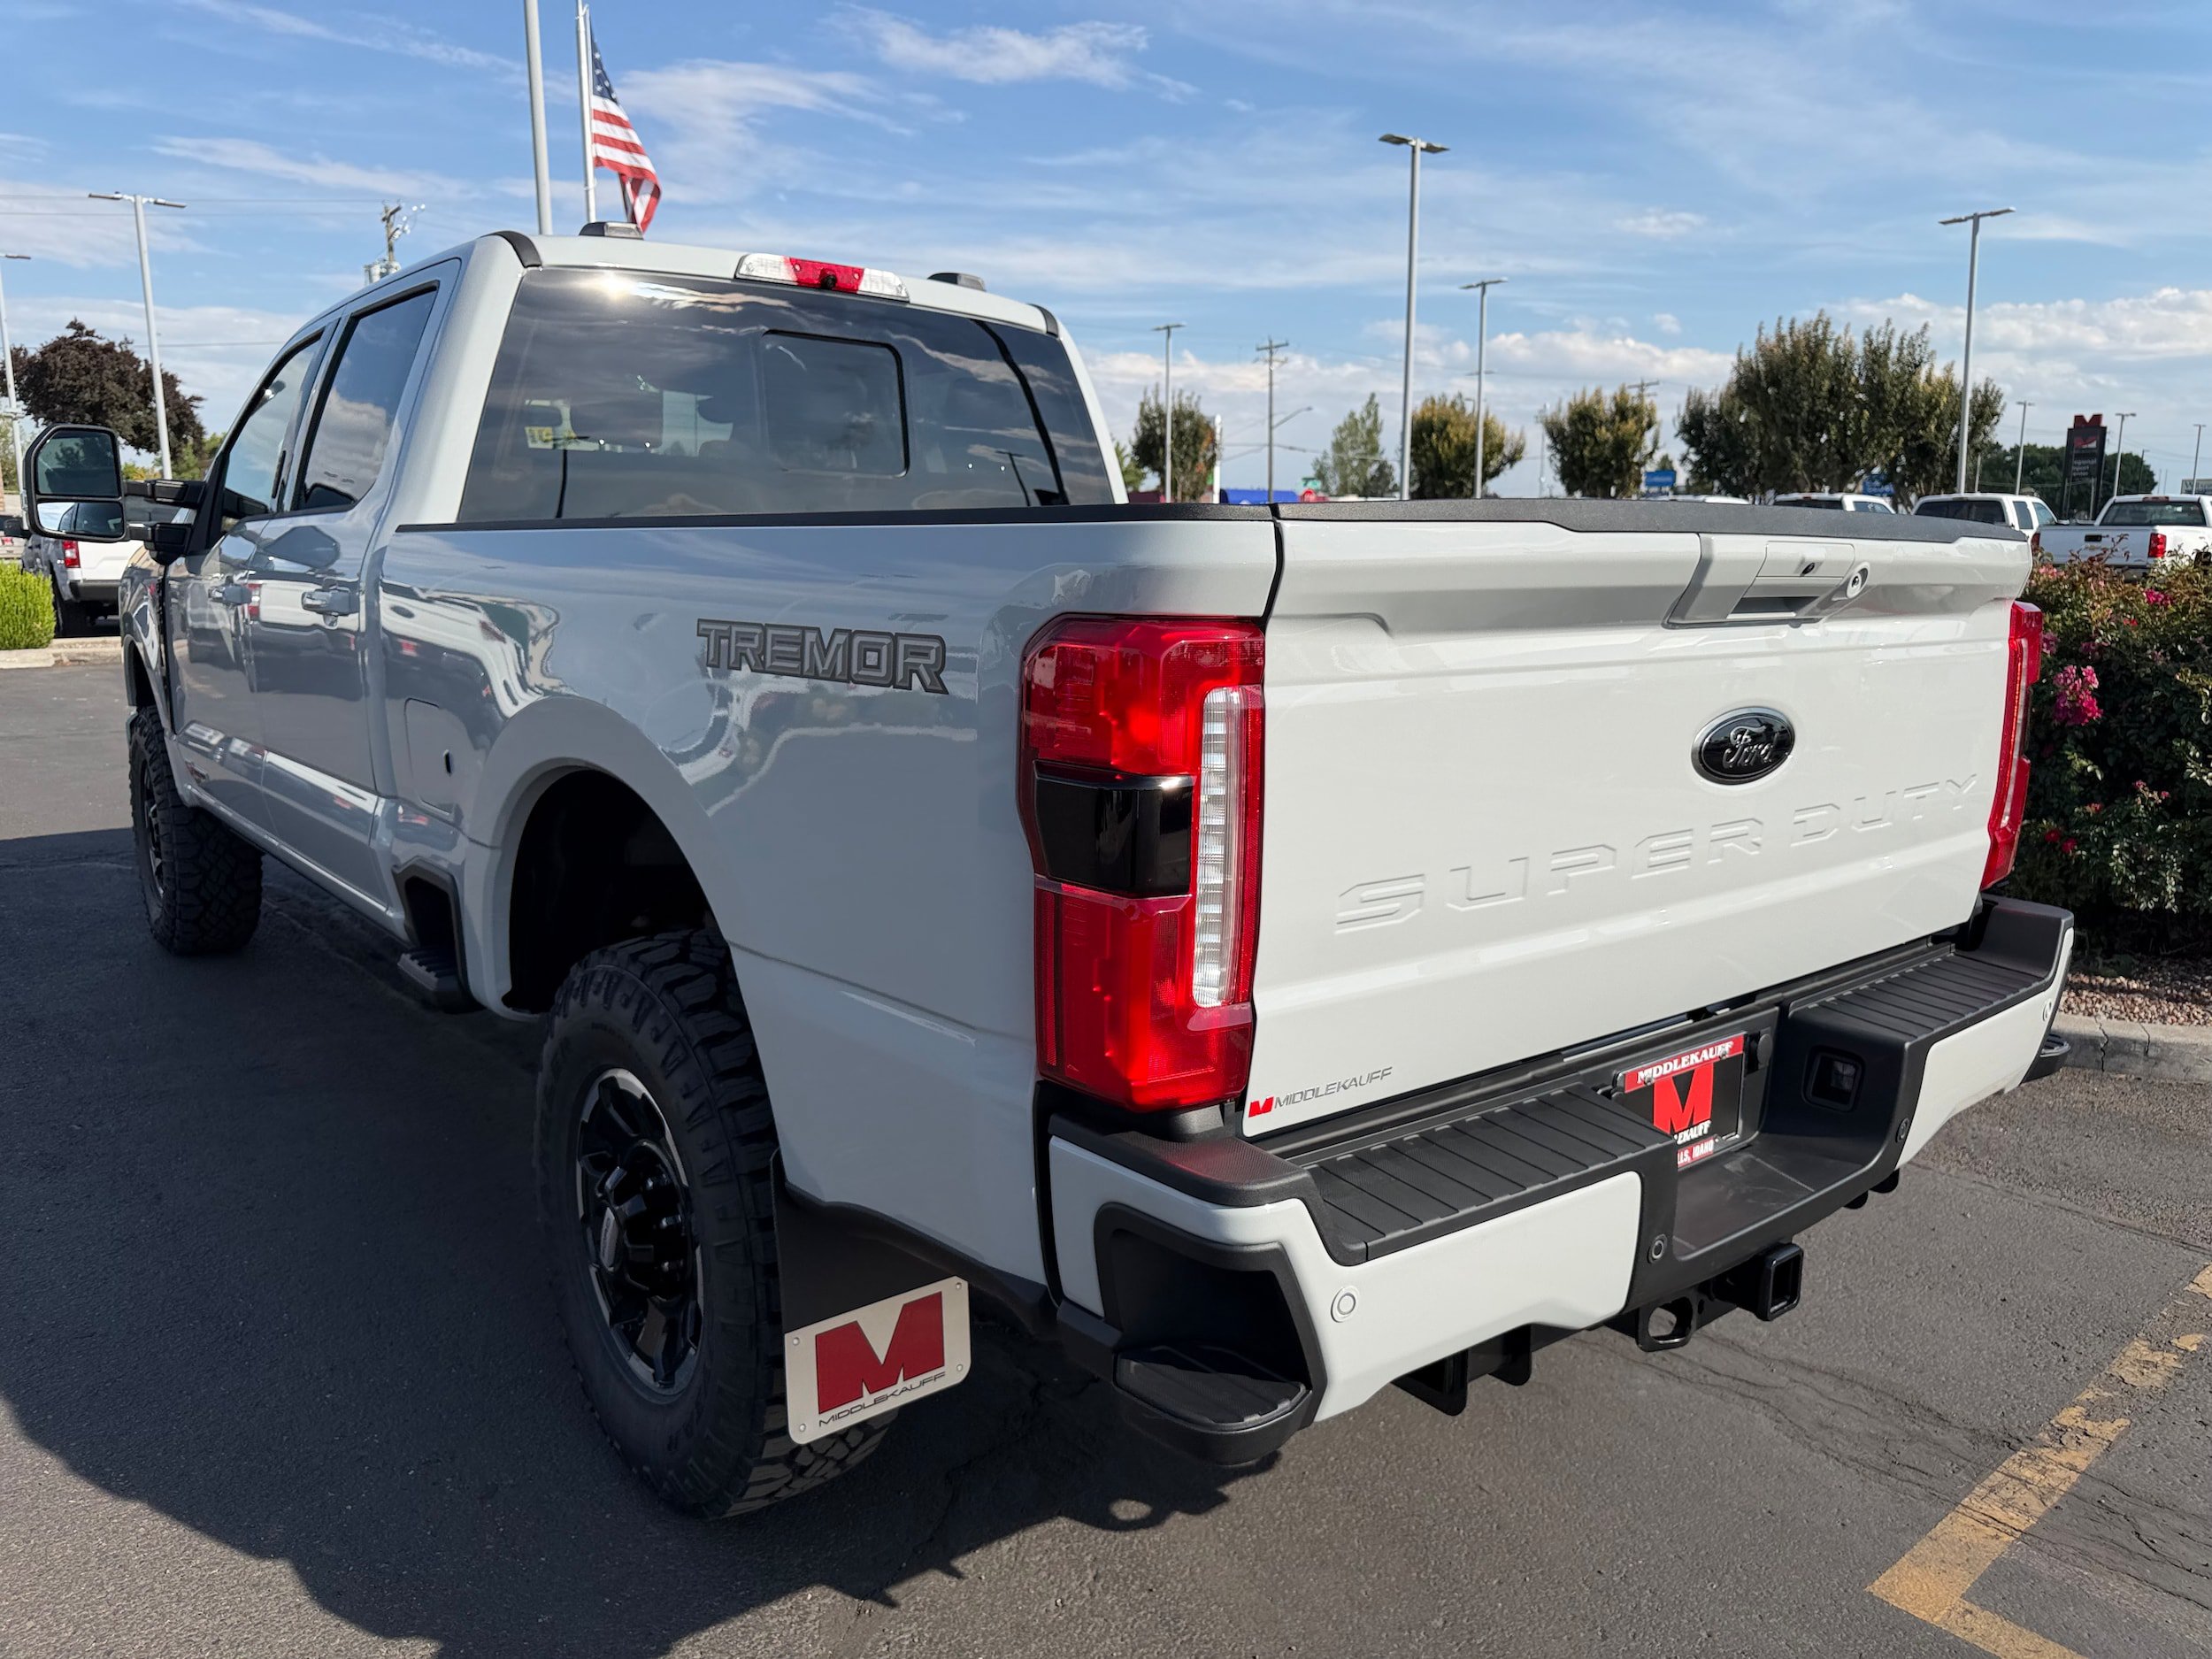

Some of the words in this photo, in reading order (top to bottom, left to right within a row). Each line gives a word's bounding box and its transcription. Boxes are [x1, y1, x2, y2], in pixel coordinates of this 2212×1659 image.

[696, 618, 949, 695] TREMOR
[1723, 725, 1779, 769] Ford
[1335, 817, 1764, 934] SUPER
[1790, 772, 1978, 847] DUTY
[1636, 1041, 1733, 1084] MIDDLEKAUFF
[1275, 1066, 1393, 1108] MIDDLEKAUFF
[1674, 1120, 1711, 1145] EKAUFF
[1692, 1139, 1714, 1159] IDAHO
[818, 1371, 946, 1427] MIDDLEKAUFF
